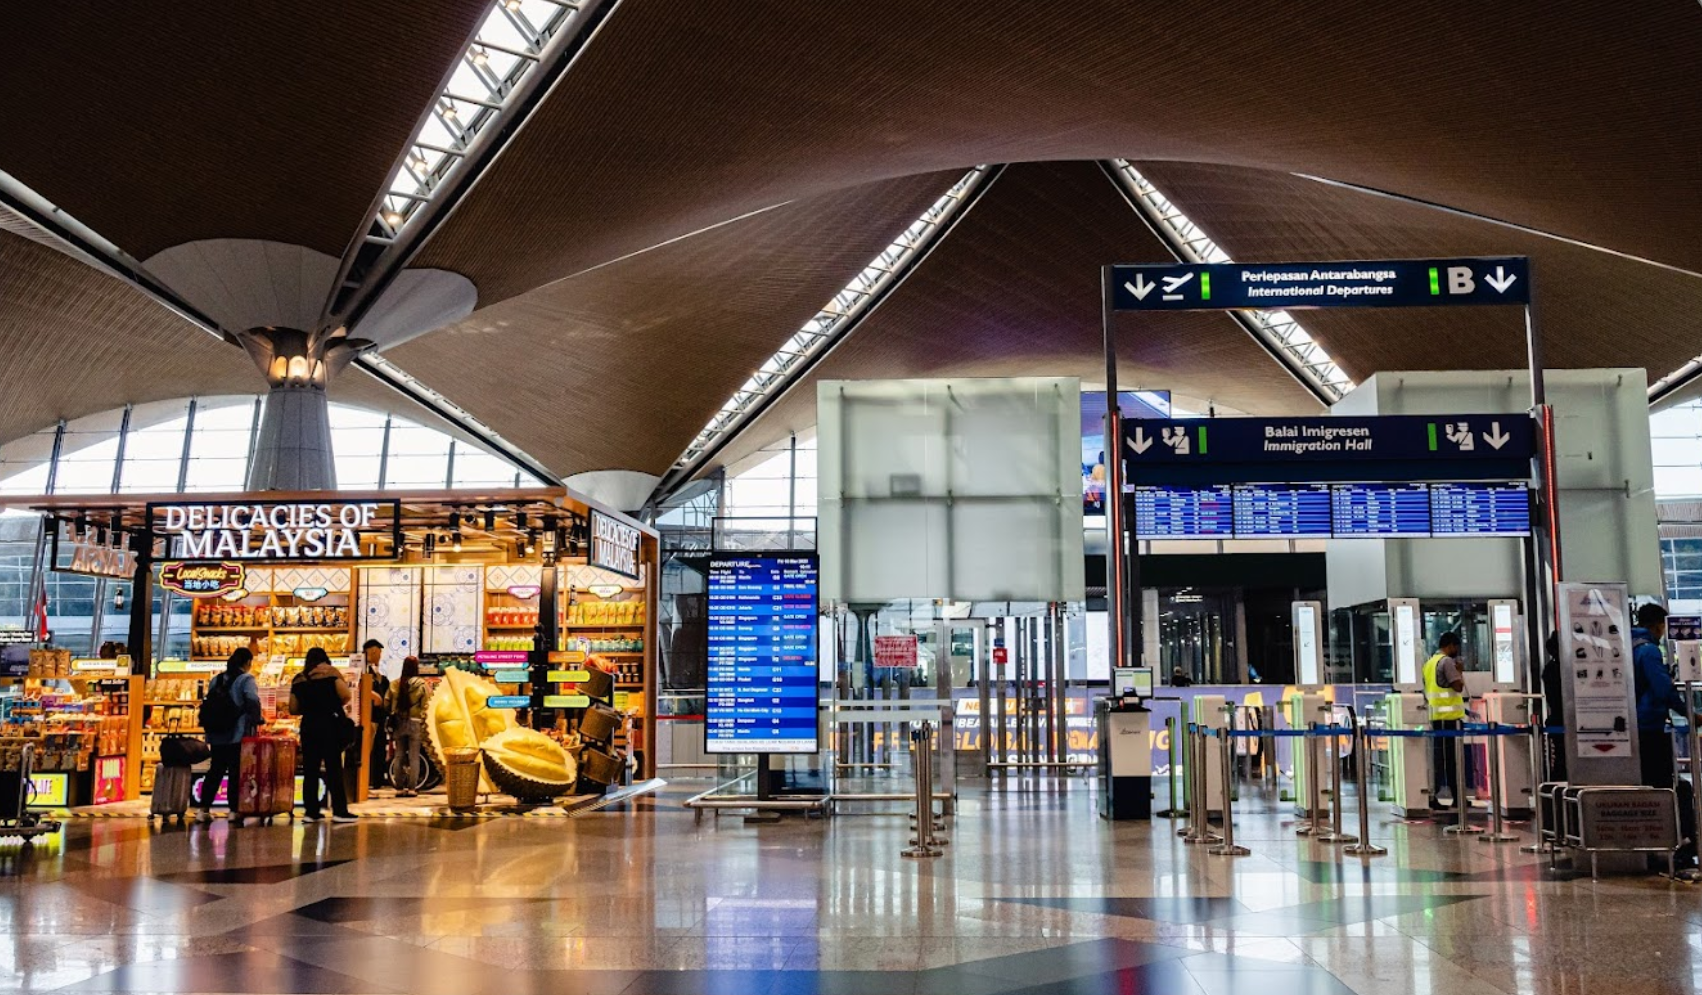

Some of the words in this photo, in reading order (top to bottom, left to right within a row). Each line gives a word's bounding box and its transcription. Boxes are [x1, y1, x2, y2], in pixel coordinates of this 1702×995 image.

[1241, 269, 1308, 284] Perlepasan
[1309, 269, 1396, 283] Antarabangsa
[1447, 266, 1475, 294] B
[1248, 285, 1324, 298] International
[1326, 284, 1393, 298] Departures
[1265, 426, 1298, 437] Balai
[1302, 425, 1369, 440] Imigresen
[1264, 439, 1341, 454] Immigration
[1345, 439, 1373, 450] Hall
[165, 504, 332, 530] DELICACIES
[339, 503, 379, 528] OF
[180, 529, 362, 559] MALAYSIA
[176, 567, 198, 580] Local
[198, 567, 228, 580] Snacks
